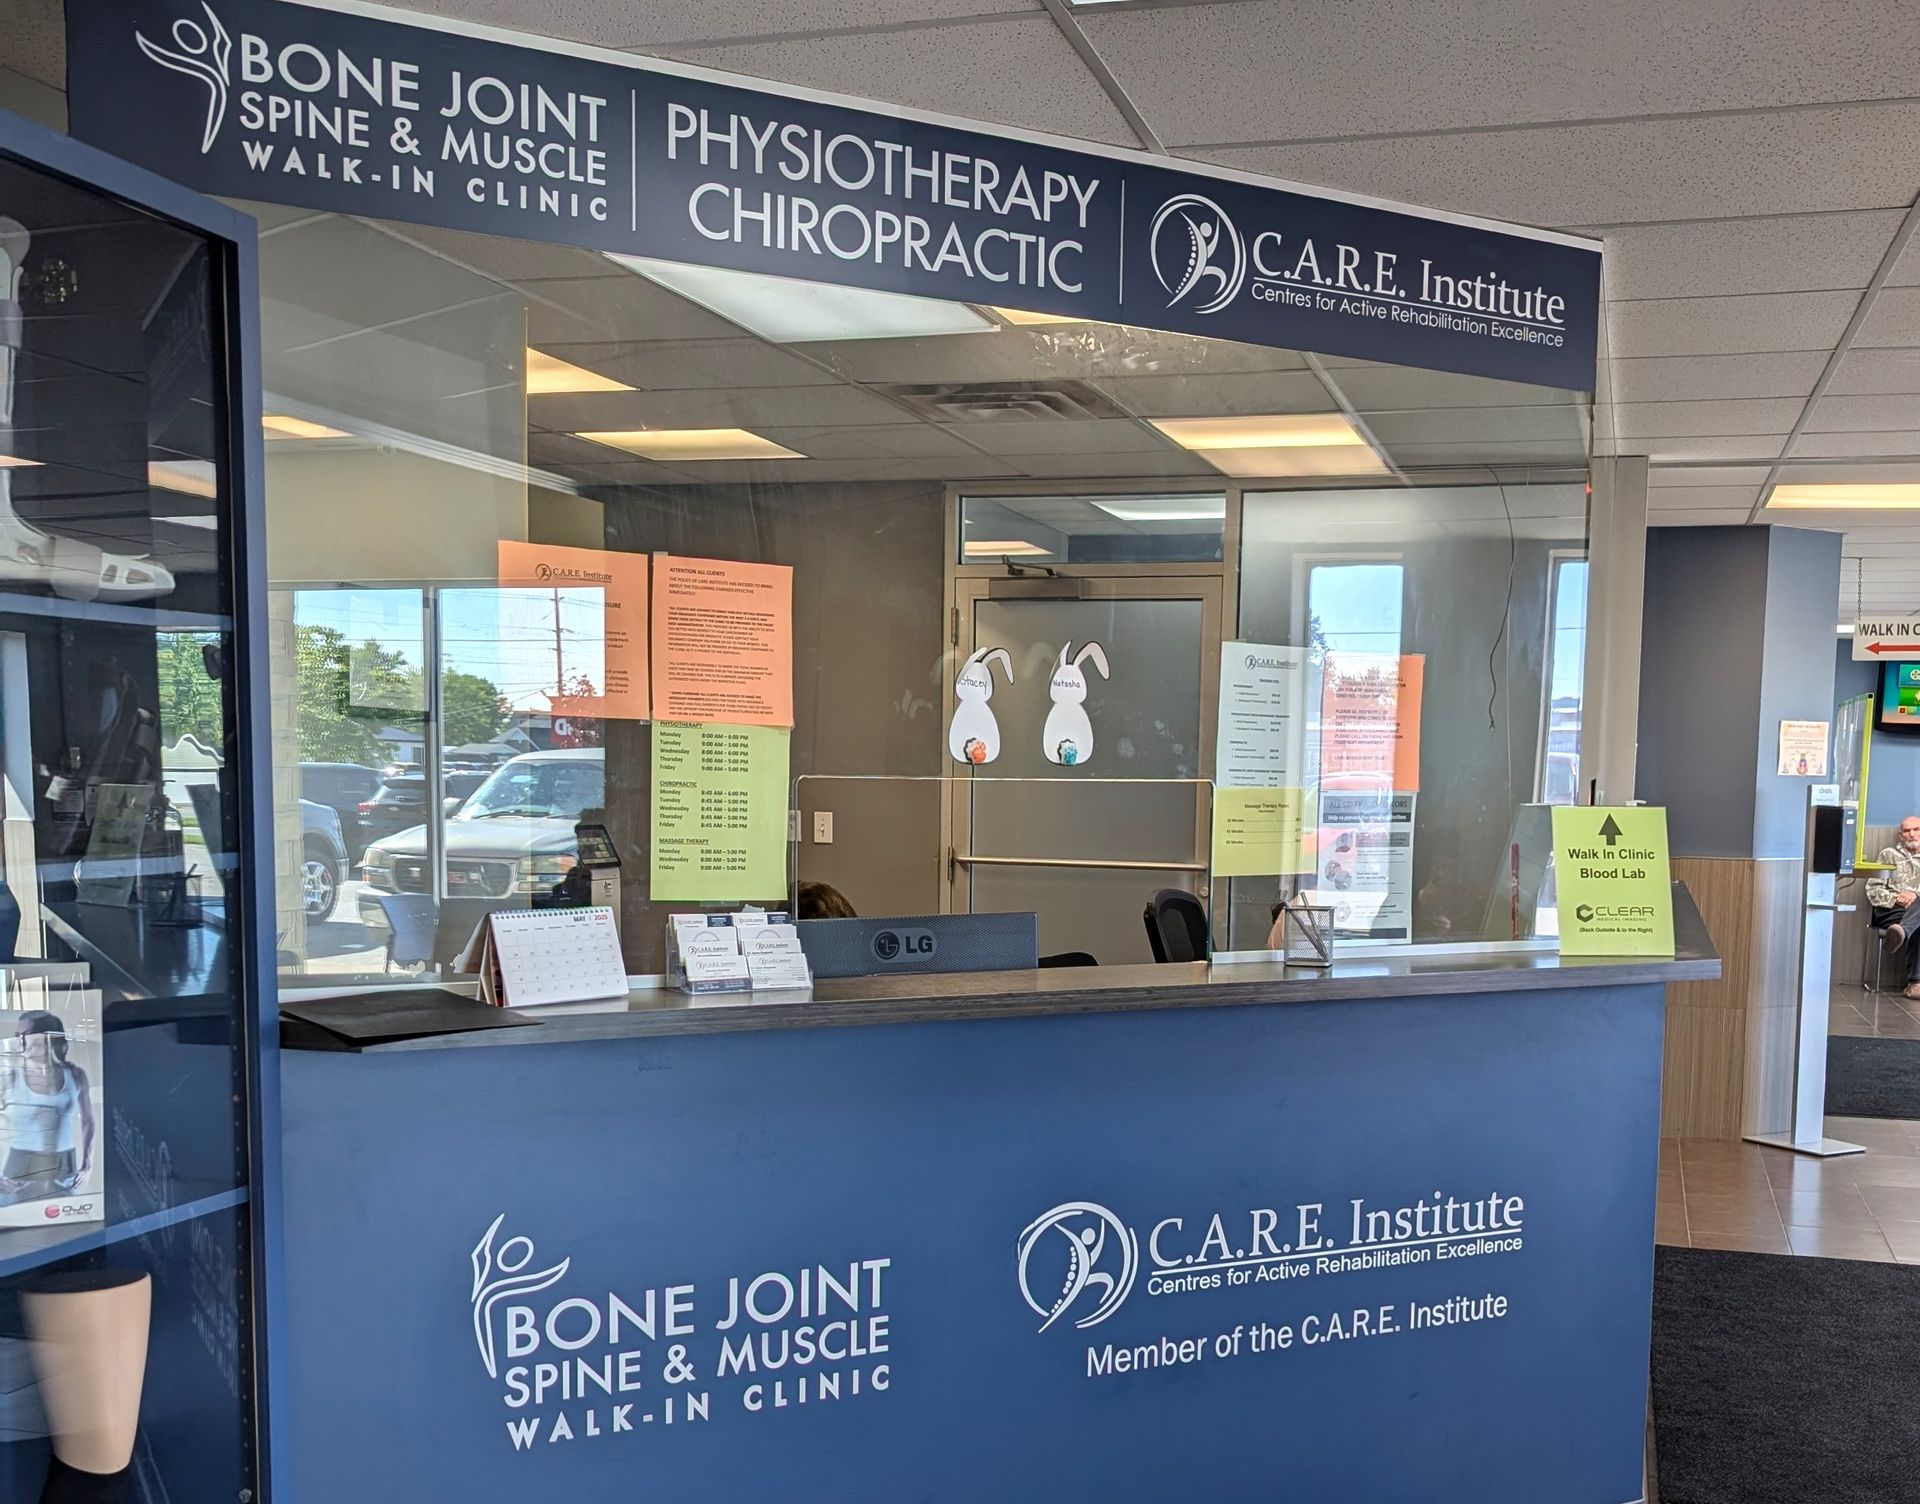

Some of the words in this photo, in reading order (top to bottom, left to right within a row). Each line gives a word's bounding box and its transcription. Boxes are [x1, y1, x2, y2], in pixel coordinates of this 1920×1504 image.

[240, 33, 420, 111] BONE
[441, 71, 607, 142] JOINT
[240, 91, 370, 148] SPINE
[390, 116, 421, 156] &
[441, 124, 607, 186] MUSCLE
[667, 103, 1099, 228] PHYSIOTHERAPY
[241, 140, 435, 198] WALK-IN
[467, 177, 608, 222] CLINIC
[689, 182, 1083, 293] CHIROPRACTIC
[1252, 231, 1406, 298] C.A.R.E.
[1419, 259, 1565, 324] Institute
[1251, 283, 1311, 308] Centres
[1315, 294, 1336, 311] for
[1339, 297, 1387, 320] Active
[1391, 305, 1487, 336] Rehabilitation
[1492, 320, 1564, 347] Excellence
[583, 570, 613, 580] Institute
[1858, 624, 1892, 636] WALK
[1896, 624, 1910, 636] IN
[958, 676, 987, 695] Stacey
[1053, 679, 1080, 688] Natasha
[1568, 849, 1600, 860] Walk
[1603, 849, 1615, 860] In
[1619, 849, 1655, 860] Clinic
[1580, 868, 1618, 879] Blood
[1622, 868, 1646, 879] Lab
[906, 936, 933, 953] LG
[1596, 906, 1654, 917] CLEAR
[62, 1204, 93, 1212] DJO
[1150, 1203, 1334, 1268] C.A.R.E.
[1348, 1190, 1524, 1246] Institute
[1148, 1271, 1221, 1296] Centres
[1226, 1265, 1252, 1286] for
[1255, 1258, 1310, 1284] Active
[1316, 1246, 1431, 1276] Rehabilitation
[1436, 1234, 1523, 1262] Excellence
[507, 1284, 695, 1358] BONE
[716, 1258, 891, 1330] JOINT
[1086, 1332, 1207, 1377] Member
[1215, 1326, 1243, 1356] of
[1249, 1322, 1293, 1353] the
[1301, 1304, 1401, 1346] C.A.R.E.
[1410, 1291, 1508, 1330] Institute
[504, 1350, 641, 1408] SPINE
[663, 1344, 696, 1384] &
[716, 1315, 889, 1377] MUSCLE
[506, 1392, 709, 1451] WALK-IN
[743, 1364, 890, 1412] CLINIC
